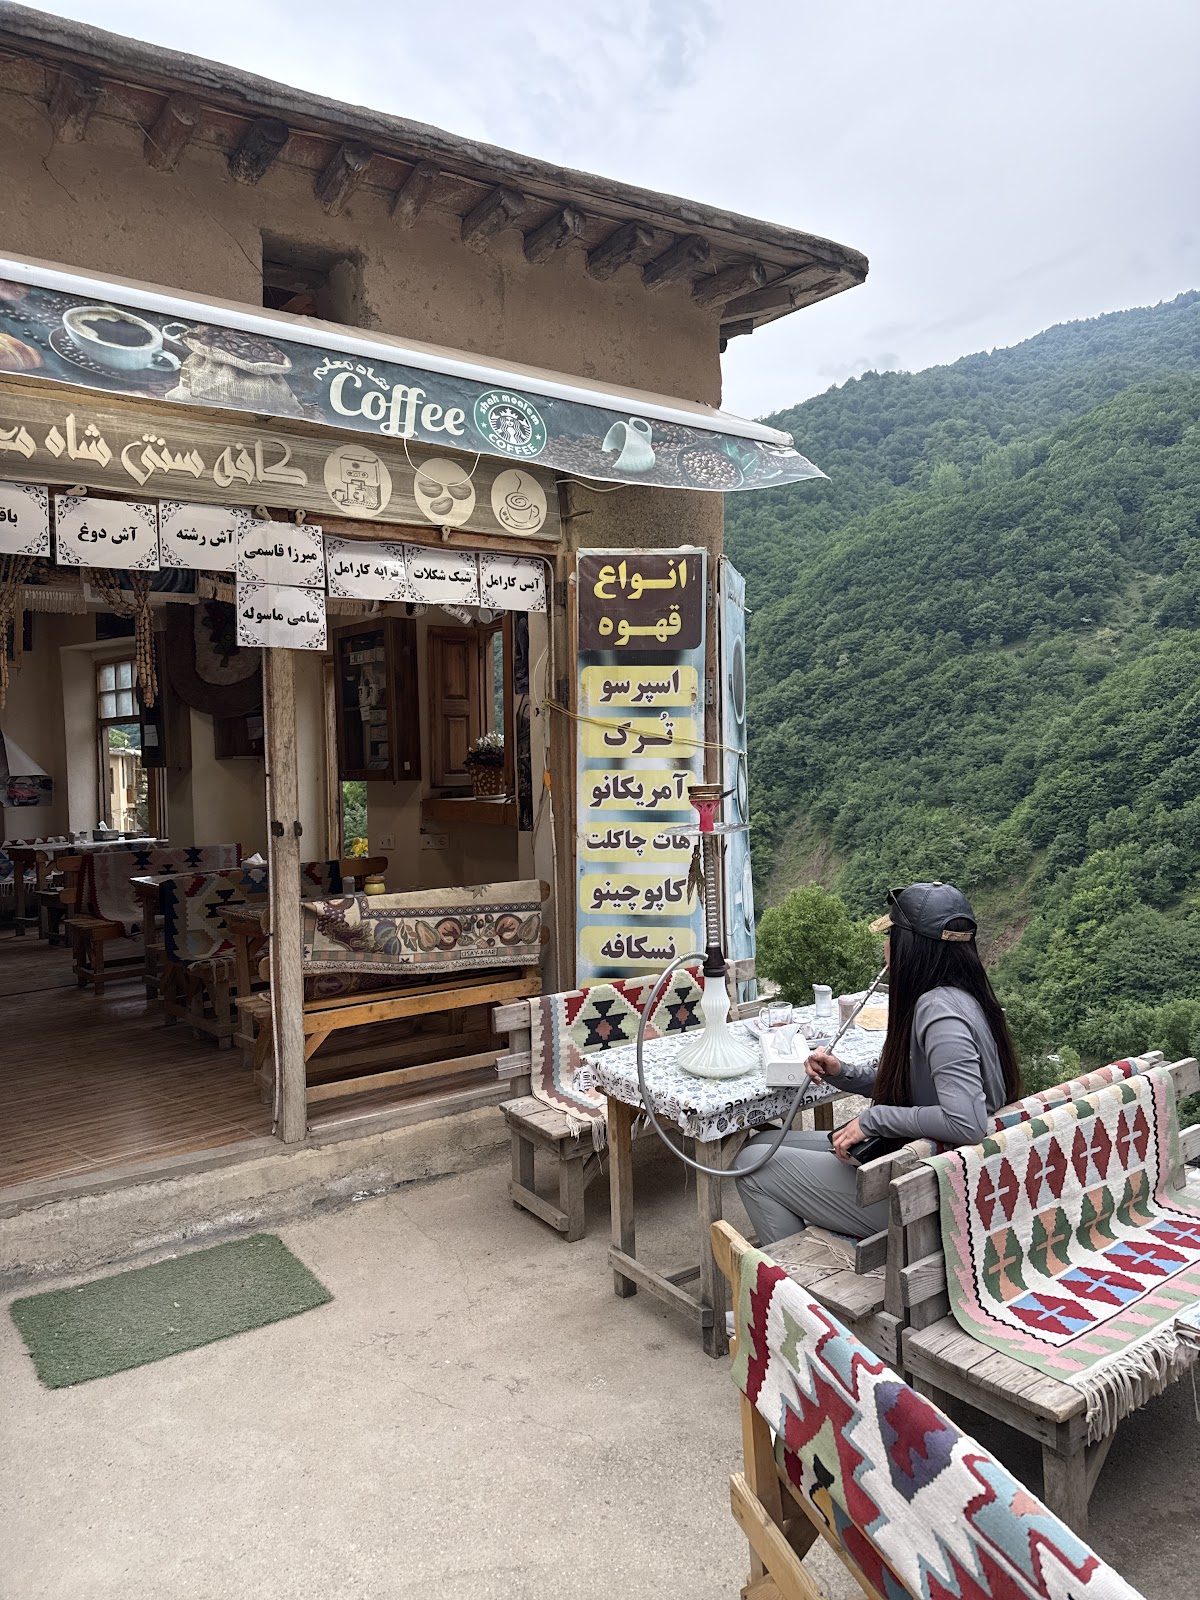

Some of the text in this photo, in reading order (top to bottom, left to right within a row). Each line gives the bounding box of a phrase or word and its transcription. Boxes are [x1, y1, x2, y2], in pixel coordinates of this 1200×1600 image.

[313, 356, 390, 391] شاه معلم
[330, 371, 466, 438] Coffee
[480, 394, 540, 426] shah moalem
[45, 413, 113, 468] شاه
[488, 433, 537, 455] COFFEE
[121, 433, 205, 487] سنتی
[213, 438, 308, 488] کافه
[77, 522, 138, 544] آش دوغ
[176, 527, 235, 546] آش رشته
[244, 543, 317, 563] میرزا قاسمی
[334, 560, 370, 578] کارامل
[413, 567, 472, 586] شیک شکلات
[486, 574, 539, 592] آیس کارامل
[593, 558, 687, 600] انواع
[242, 606, 319, 626] شامی ماسوله
[598, 604, 682, 646] قهوه
[599, 669, 680, 704] اسپرسو
[589, 773, 688, 808] آمریکانو
[586, 829, 691, 857] هات چاکلت
[590, 878, 687, 911] کاپوچینو
[600, 933, 676, 961] نسکافه
